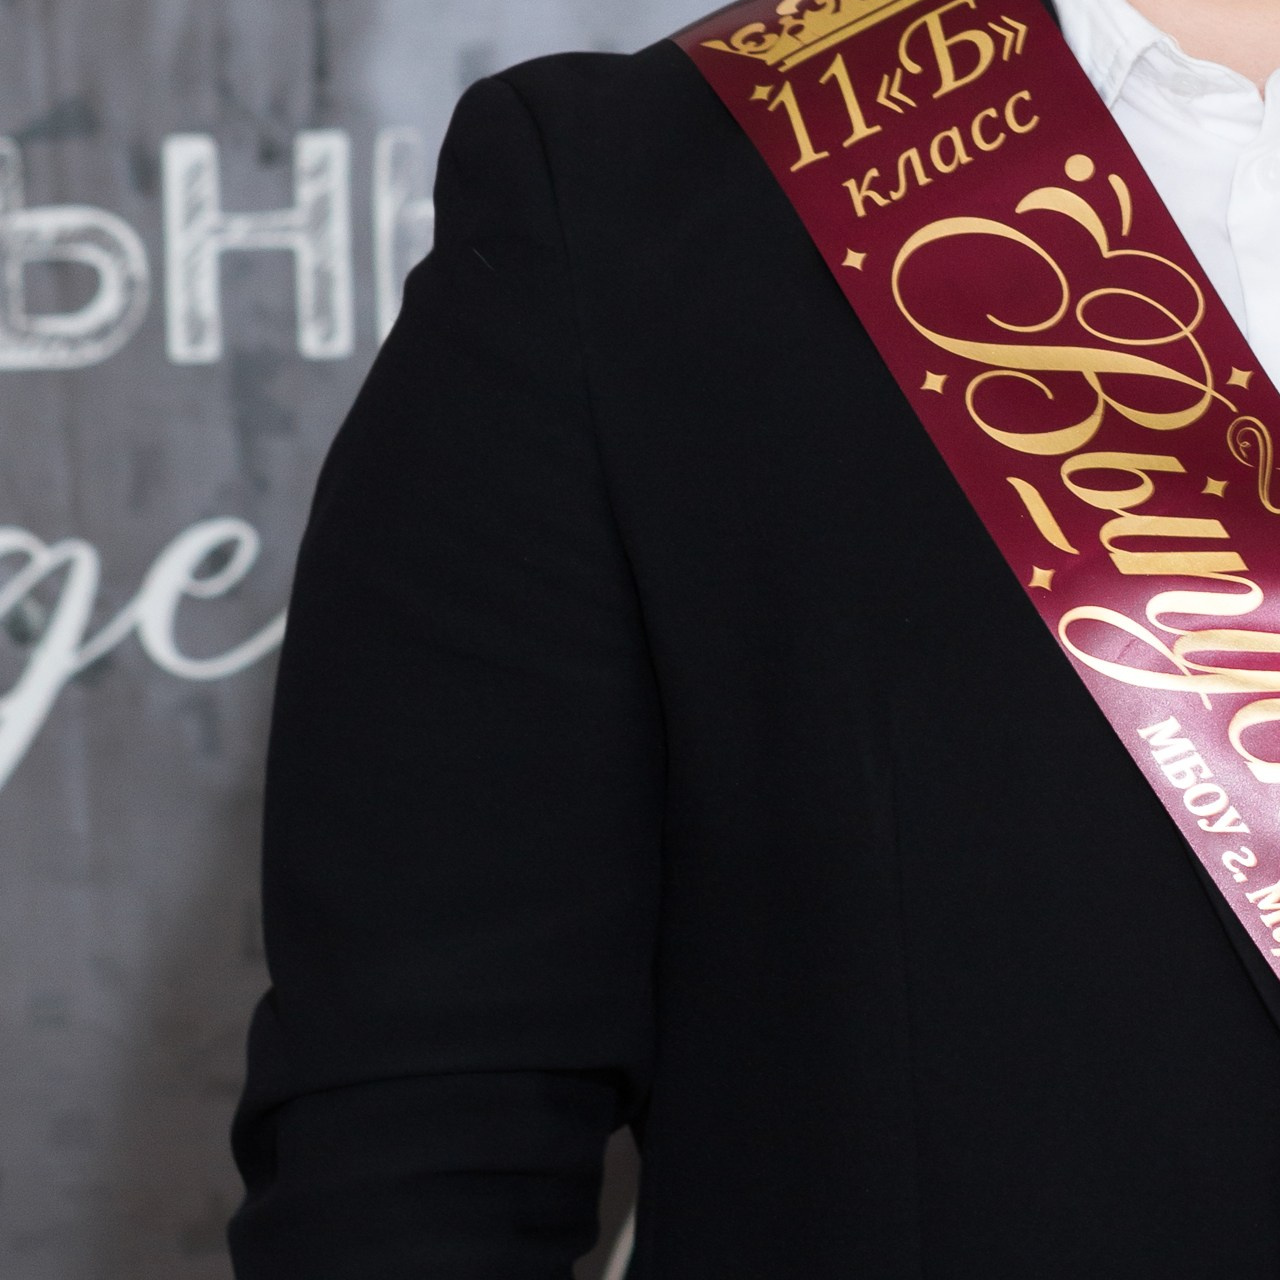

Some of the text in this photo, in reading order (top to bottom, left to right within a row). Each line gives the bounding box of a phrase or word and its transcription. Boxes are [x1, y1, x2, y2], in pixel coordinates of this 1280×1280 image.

[842, 88, 1040, 217] класс
[1137, 715, 1250, 835] МБОУ
[1221, 846, 1258, 884] г.
